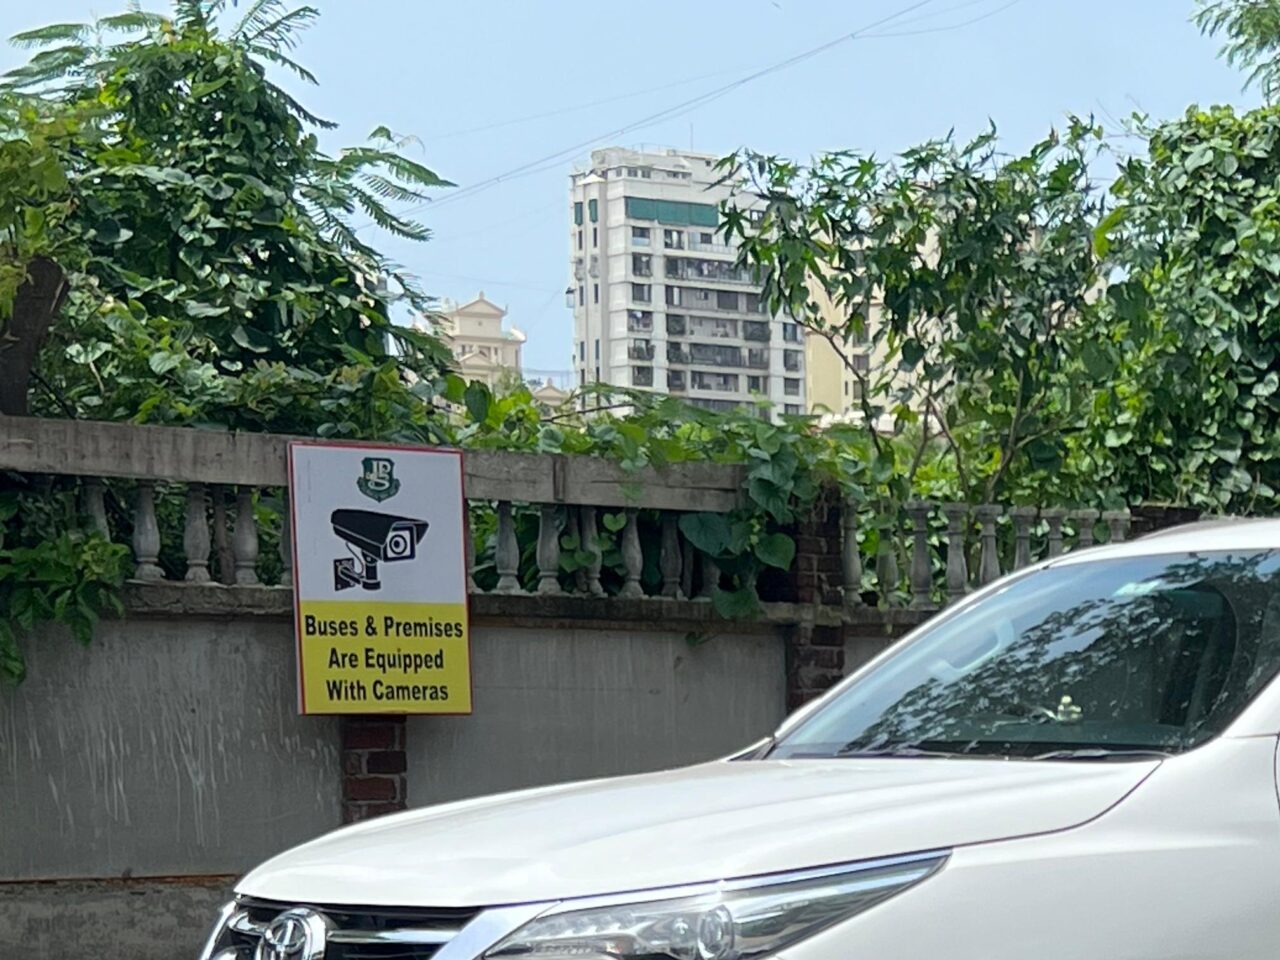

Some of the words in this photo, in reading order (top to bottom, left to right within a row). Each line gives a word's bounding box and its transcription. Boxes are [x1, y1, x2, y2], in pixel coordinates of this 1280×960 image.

[304, 615, 359, 637] Buses
[365, 616, 378, 637] &
[384, 618, 464, 638] Premises
[328, 648, 359, 668] Are
[365, 648, 444, 674] Equipped
[326, 680, 367, 700] With
[372, 680, 449, 700] Cameras
